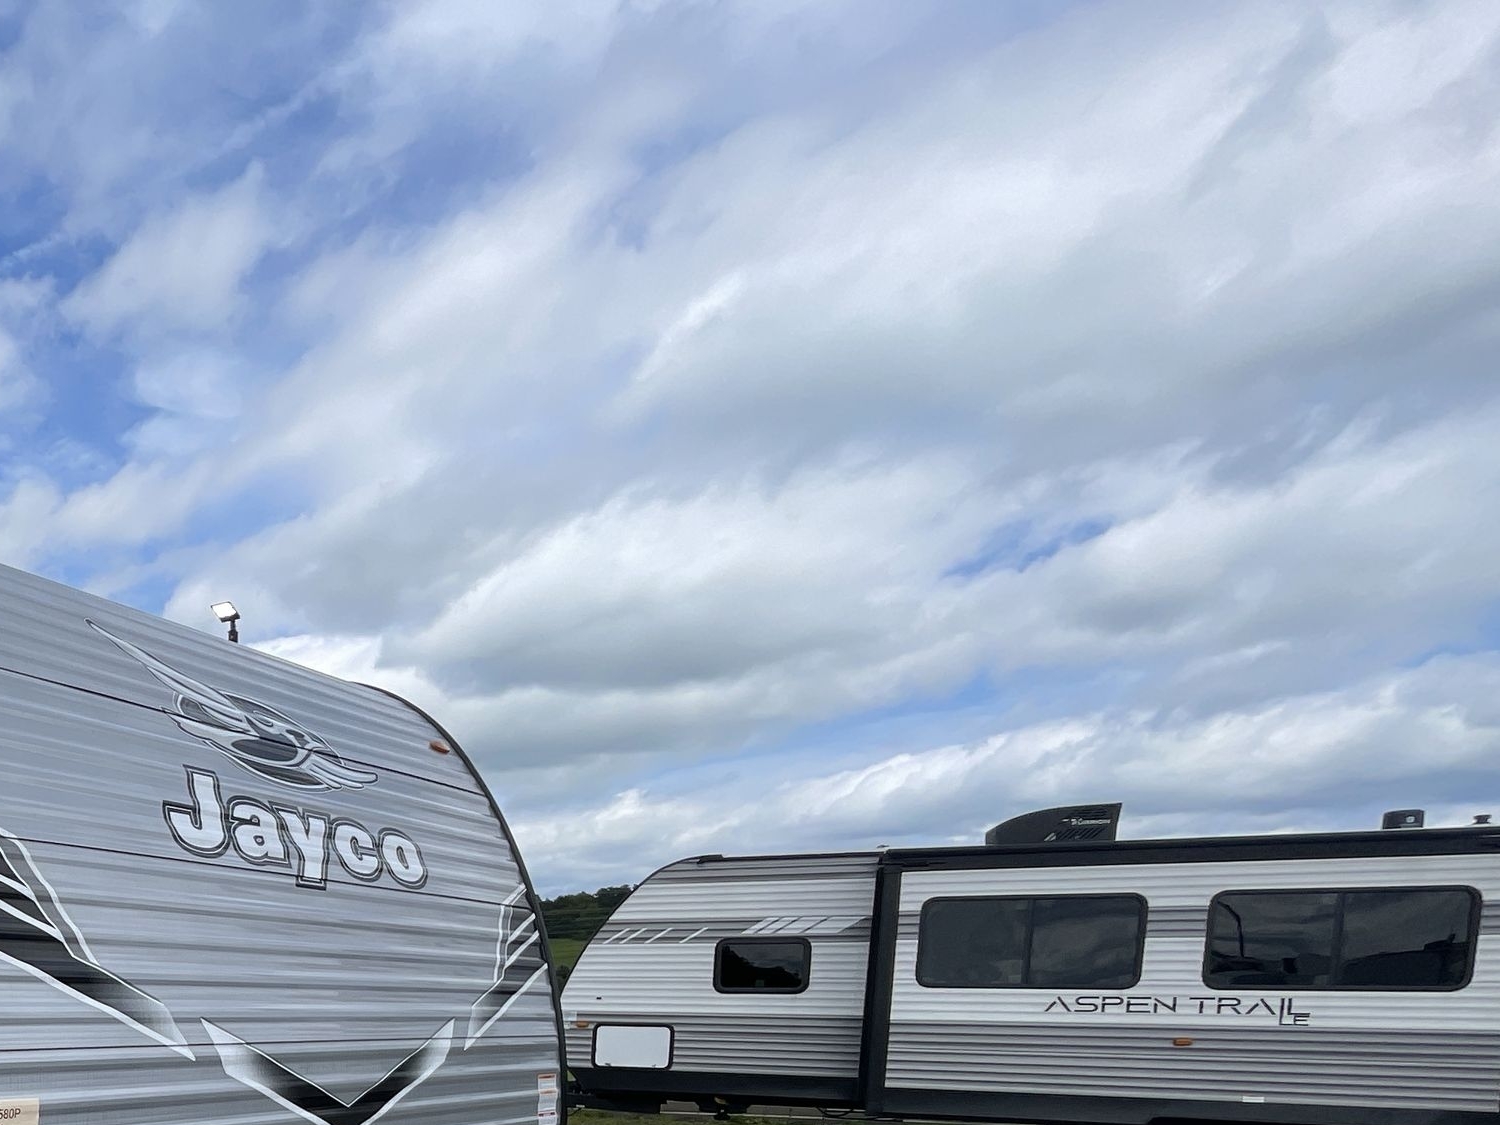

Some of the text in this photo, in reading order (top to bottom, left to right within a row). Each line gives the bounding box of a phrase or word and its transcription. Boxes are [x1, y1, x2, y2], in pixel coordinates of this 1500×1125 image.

[162, 764, 428, 891] Jayco
[1044, 996, 1311, 1017] ASPEN TRAIL
